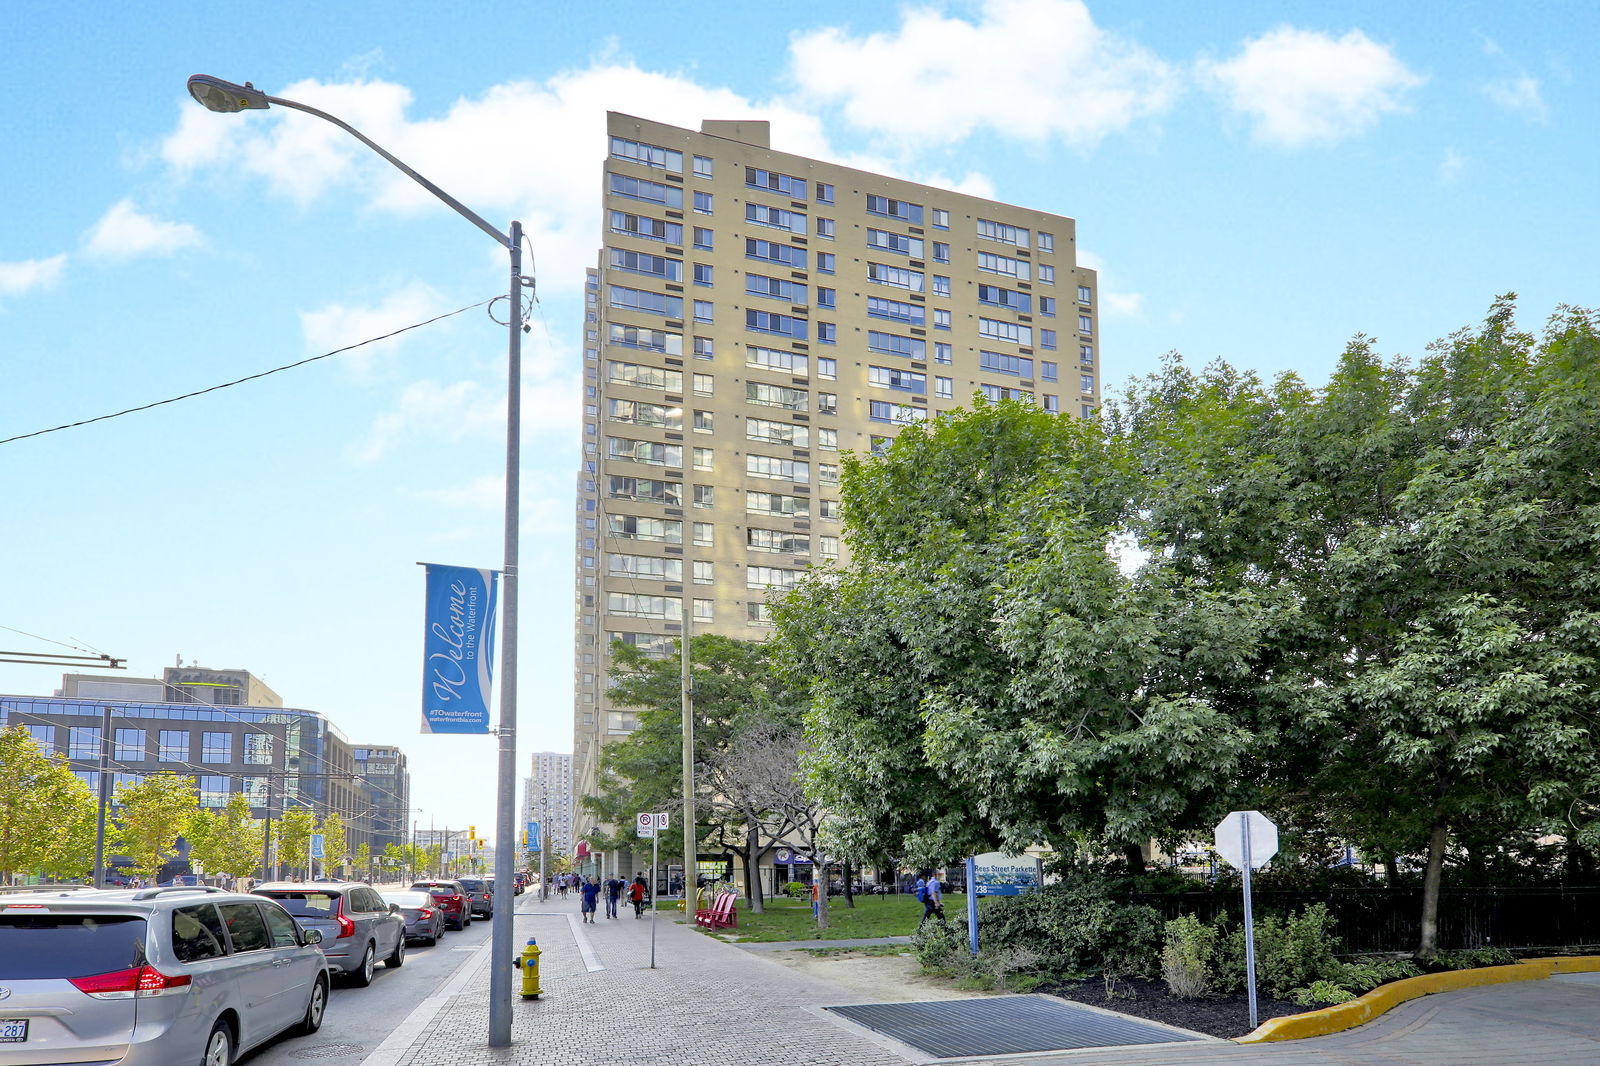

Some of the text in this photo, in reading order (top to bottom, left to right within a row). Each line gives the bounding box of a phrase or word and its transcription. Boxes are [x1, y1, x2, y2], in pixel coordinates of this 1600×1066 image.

[429, 579, 467, 702] Welcome
[466, 586, 478, 660] to the Waterfront
[430, 709, 483, 718] #TOwaterfront
[975, 885, 988, 894] 238
